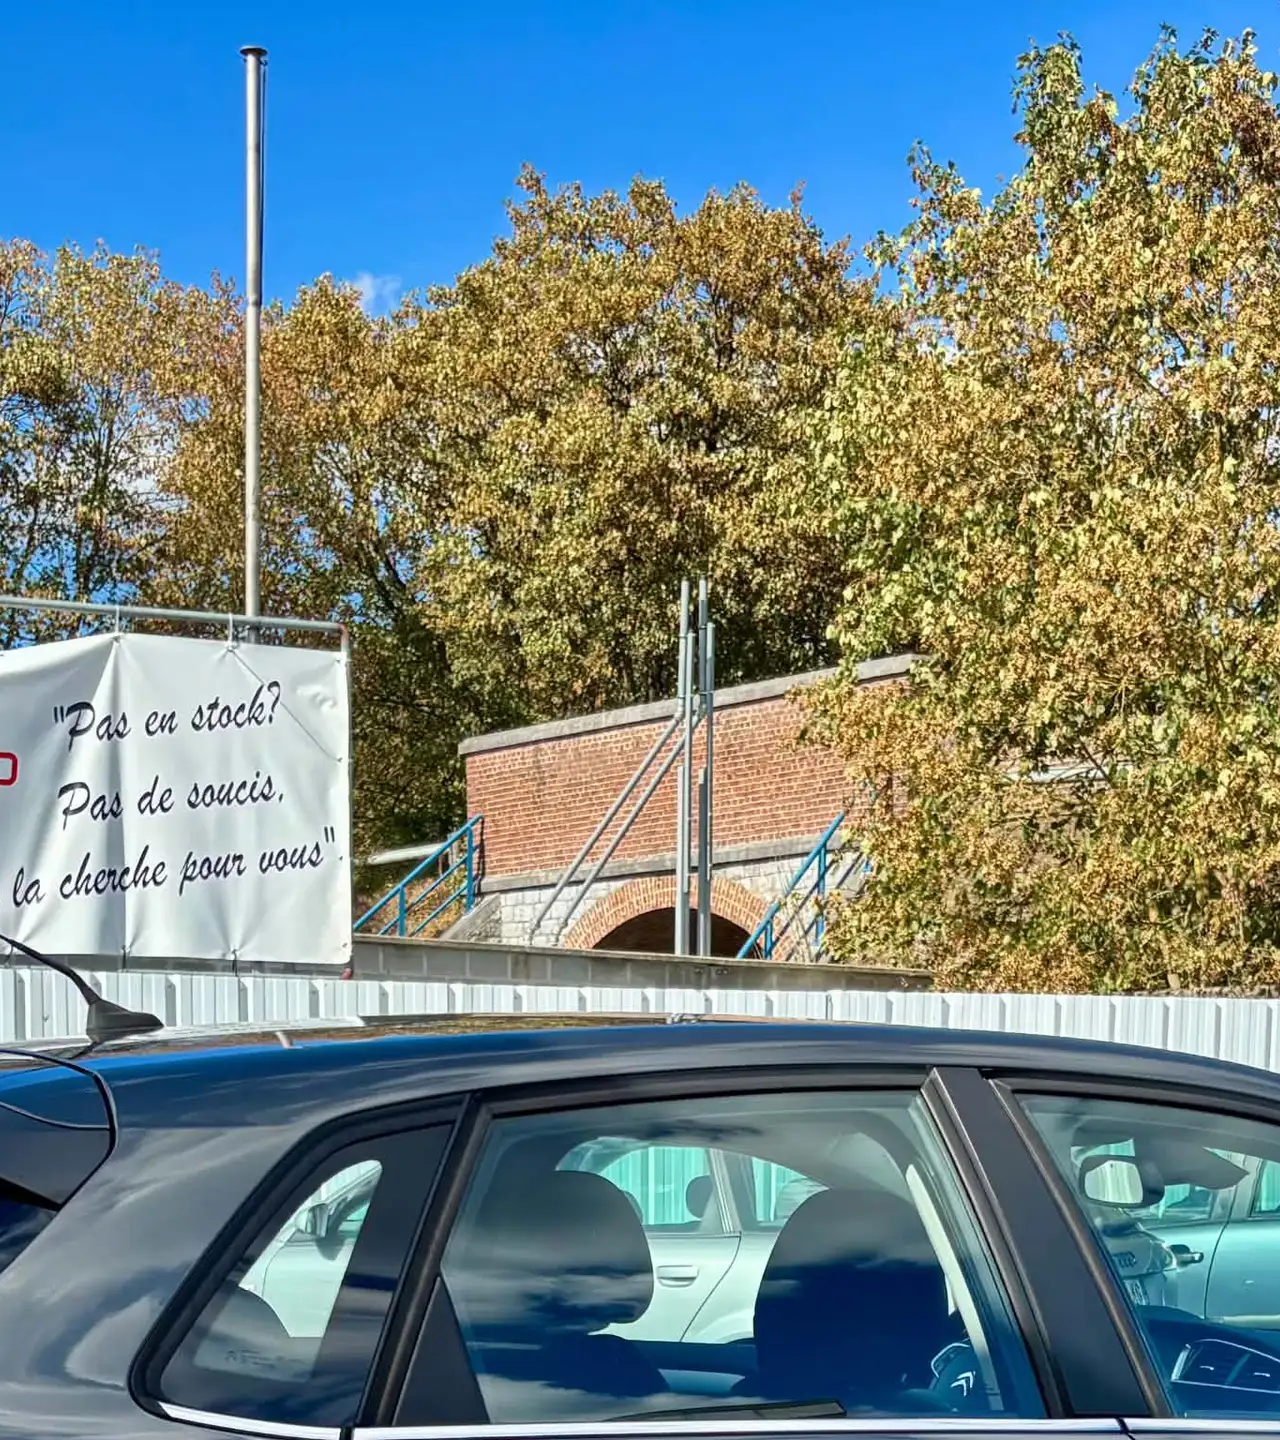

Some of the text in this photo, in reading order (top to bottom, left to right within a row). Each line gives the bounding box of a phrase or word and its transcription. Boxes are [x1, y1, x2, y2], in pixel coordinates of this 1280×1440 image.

[53, 680, 281, 752] "Pas en stock?
[57, 781, 124, 830] Pas
[137, 775, 174, 815] de
[12, 867, 46, 904] la
[59, 844, 168, 900] cherche
[179, 851, 246, 897] pour
[258, 826, 336, 874] vous"
